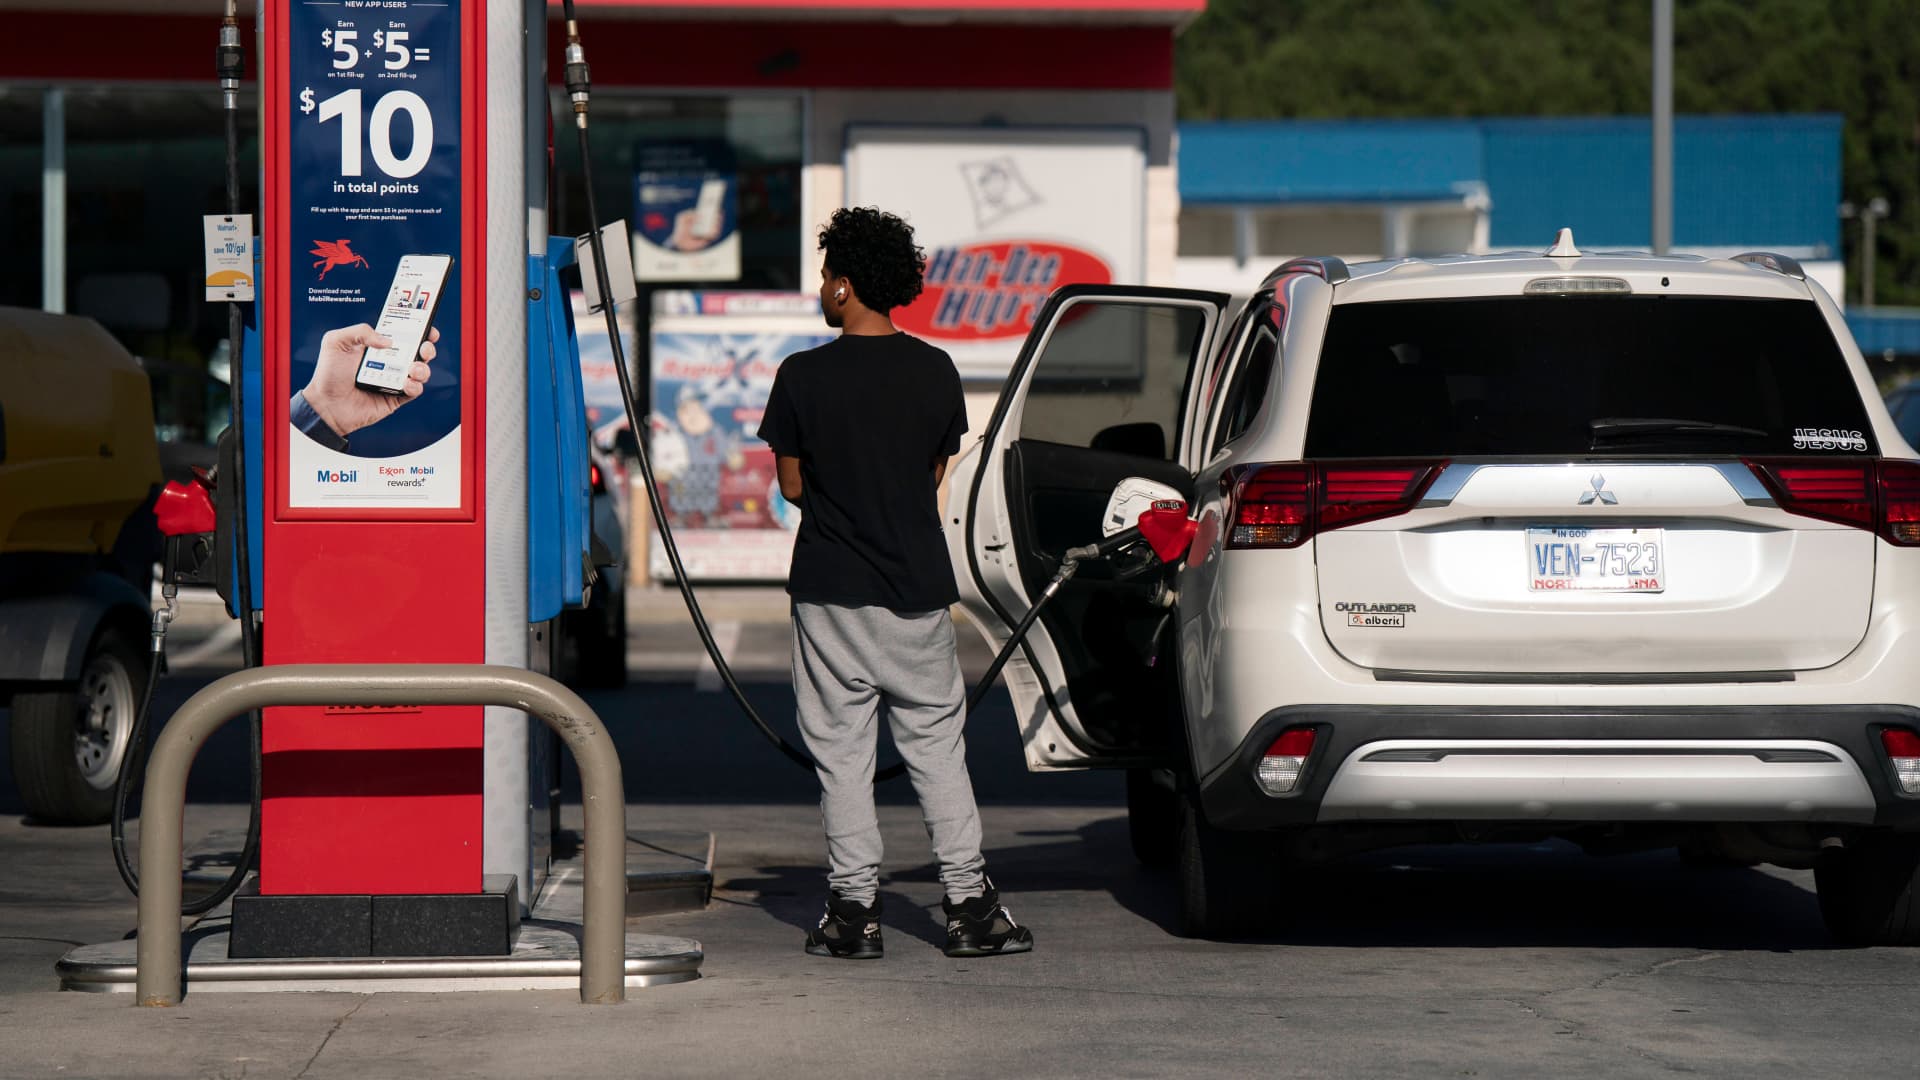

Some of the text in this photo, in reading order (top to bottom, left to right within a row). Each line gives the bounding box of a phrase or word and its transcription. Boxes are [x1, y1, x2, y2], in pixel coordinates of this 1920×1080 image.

[399, 72, 417, 80] fill-up
[300, 87, 434, 179] $10
[333, 181, 419, 196] in total points
[308, 287, 339, 295] Download
[308, 295, 366, 303] MobilRewards.com
[1793, 428, 1867, 451] JESUS
[317, 470, 357, 483] Mobil
[379, 466, 434, 476] Exxon Mobil
[1557, 530, 1567, 538] IN
[1535, 543, 1658, 577] VEN-7523
[1335, 601, 1416, 613] OUTLANDER
